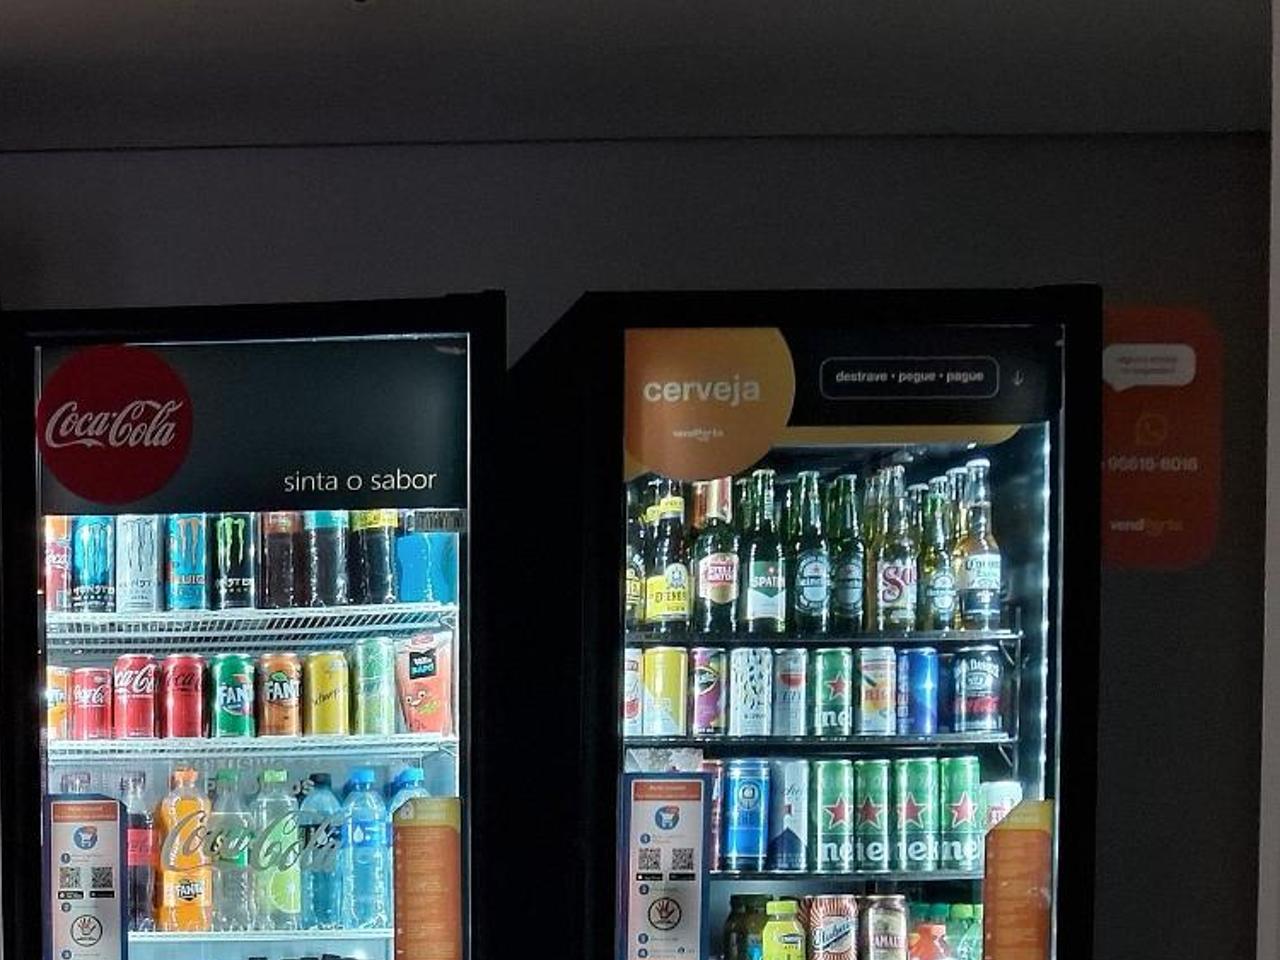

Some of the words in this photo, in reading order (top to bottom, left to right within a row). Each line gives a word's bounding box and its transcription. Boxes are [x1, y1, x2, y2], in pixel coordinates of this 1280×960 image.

[642, 374, 761, 407] cerveja
[835, 371, 888, 383] destrave
[44, 400, 185, 448] Coca-Cola
[283, 470, 338, 492] sinta
[346, 473, 362, 490] o
[370, 469, 437, 490] sabor
